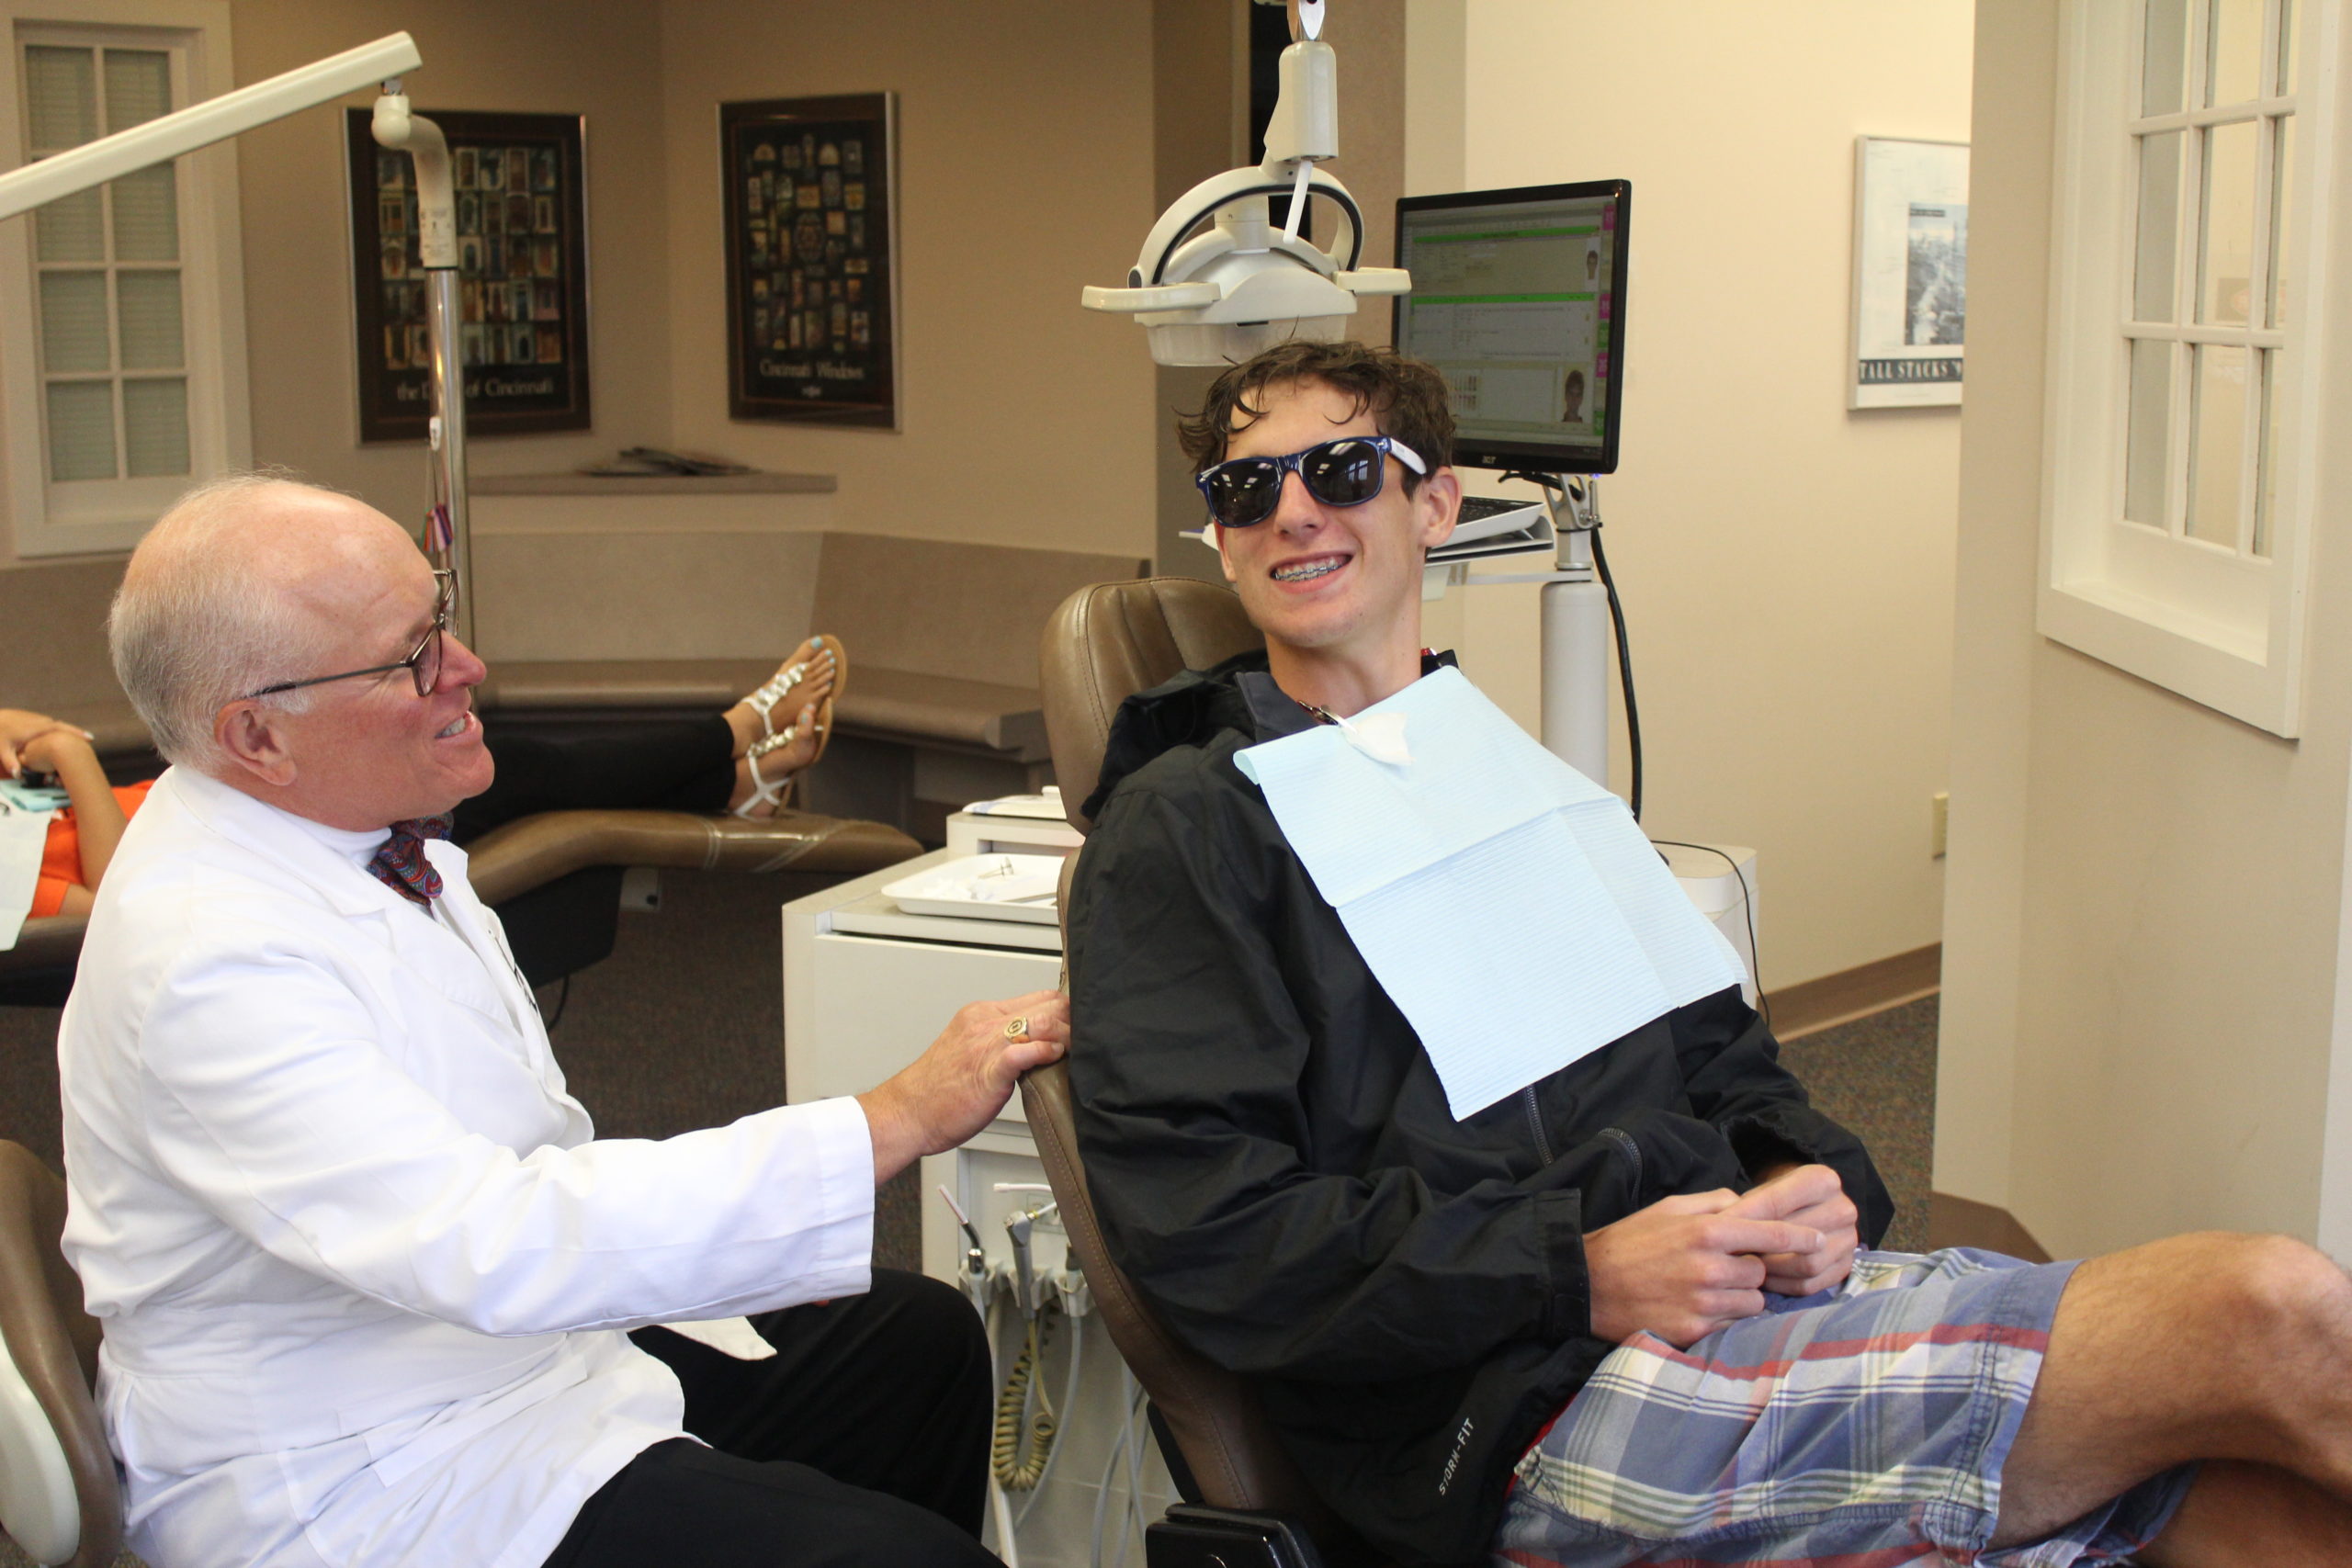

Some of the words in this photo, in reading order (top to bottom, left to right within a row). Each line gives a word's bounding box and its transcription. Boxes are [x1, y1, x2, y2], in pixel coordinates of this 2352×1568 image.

[1859, 361, 1893, 379] TALL
[1897, 360, 1948, 378] STACKS
[1438, 1416, 1475, 1496] STORM-FIT
